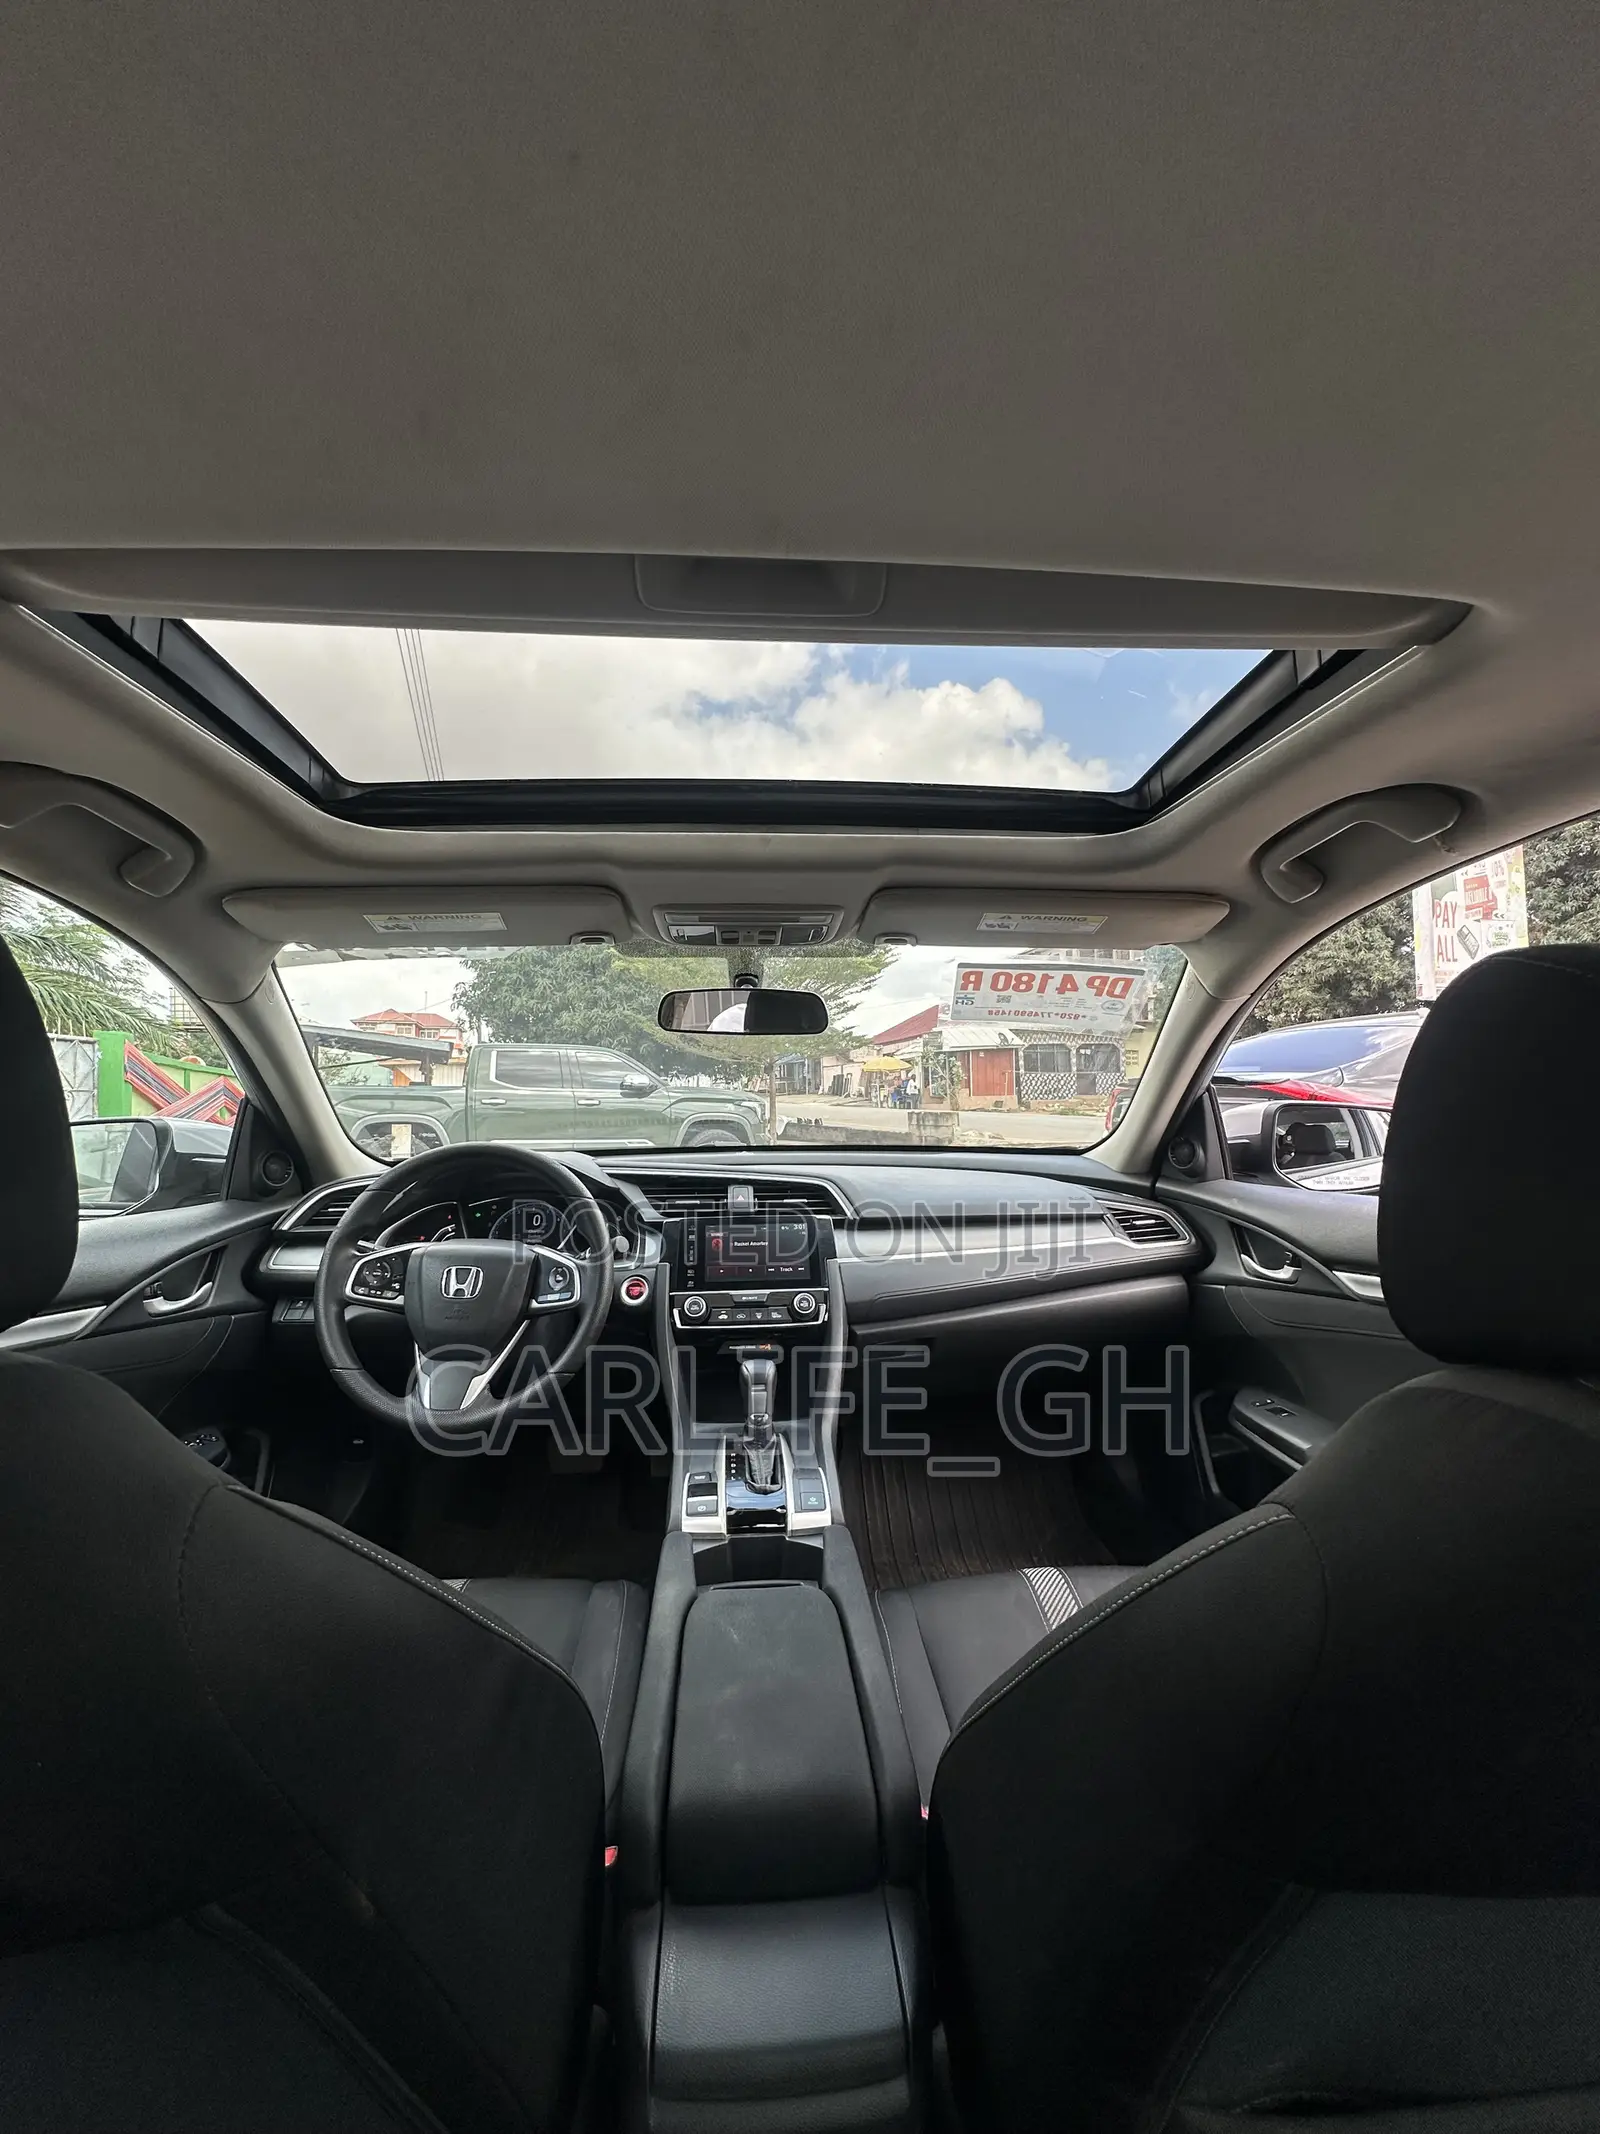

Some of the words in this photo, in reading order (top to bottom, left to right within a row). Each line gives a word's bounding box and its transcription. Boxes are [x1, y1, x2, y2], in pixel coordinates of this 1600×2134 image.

[408, 913, 482, 921] WARNING
[1434, 901, 1457, 929] PAY
[1437, 934, 1458, 963] ALL
[533, 1214, 541, 1227] 0
